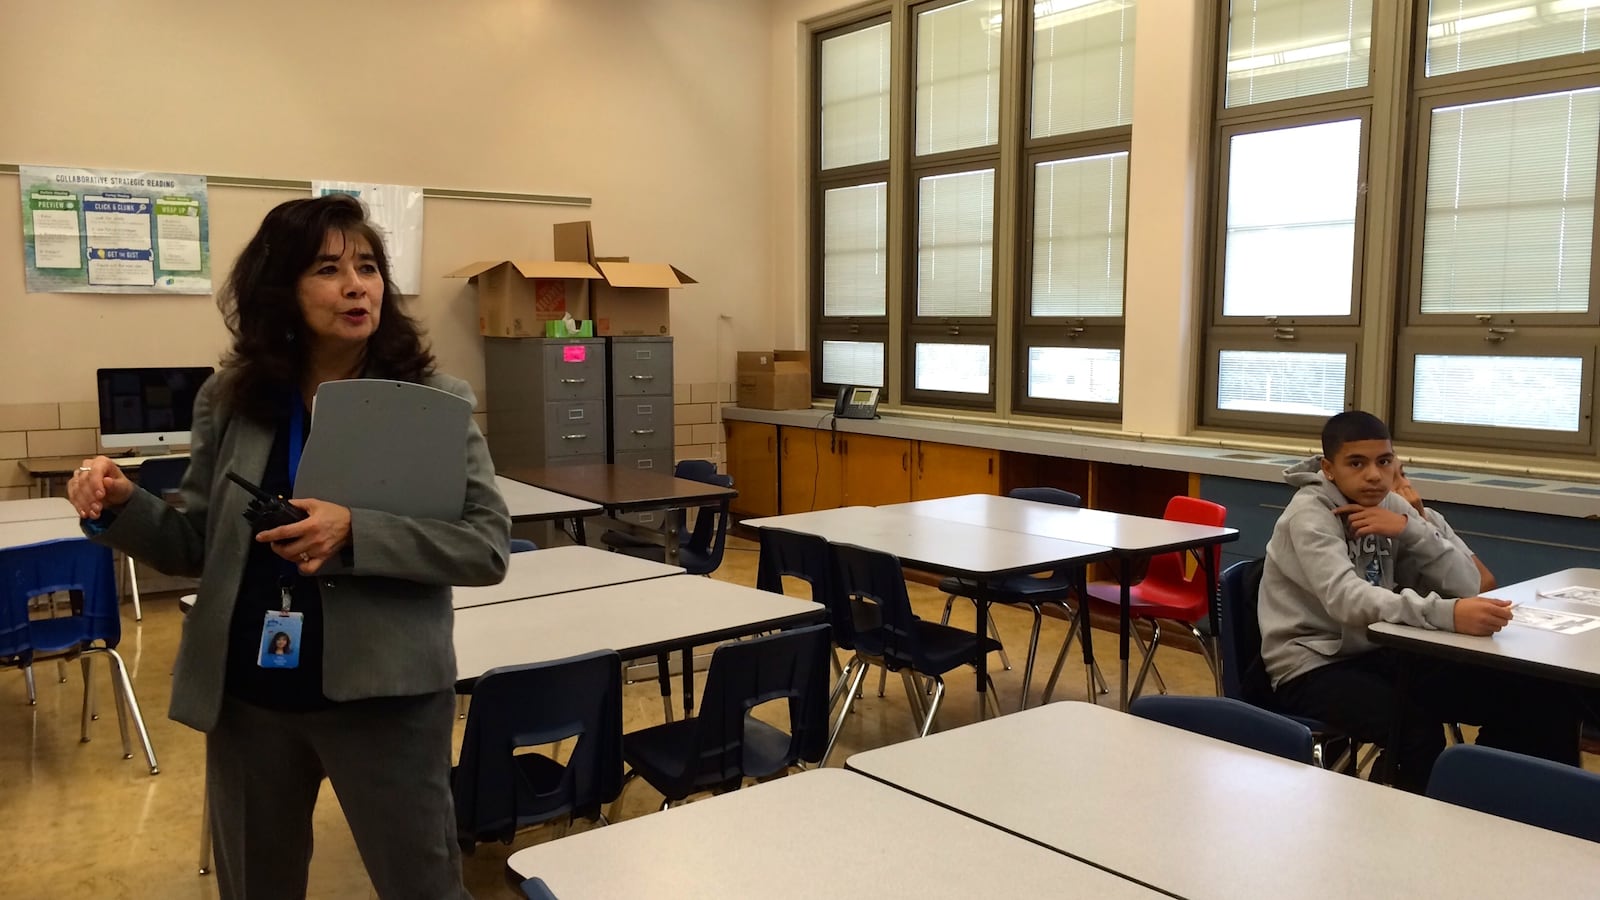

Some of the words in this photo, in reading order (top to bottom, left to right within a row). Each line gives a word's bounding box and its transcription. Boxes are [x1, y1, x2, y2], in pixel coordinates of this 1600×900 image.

[55, 174, 108, 184] COLLABORATIVE
[110, 177, 145, 187] STRATEGIC
[147, 179, 175, 188] READING
[37, 201, 65, 209] PREVIEW
[94, 203, 111, 211] CLICK
[117, 204, 135, 212] CLUNK
[107, 250, 118, 258] GET
